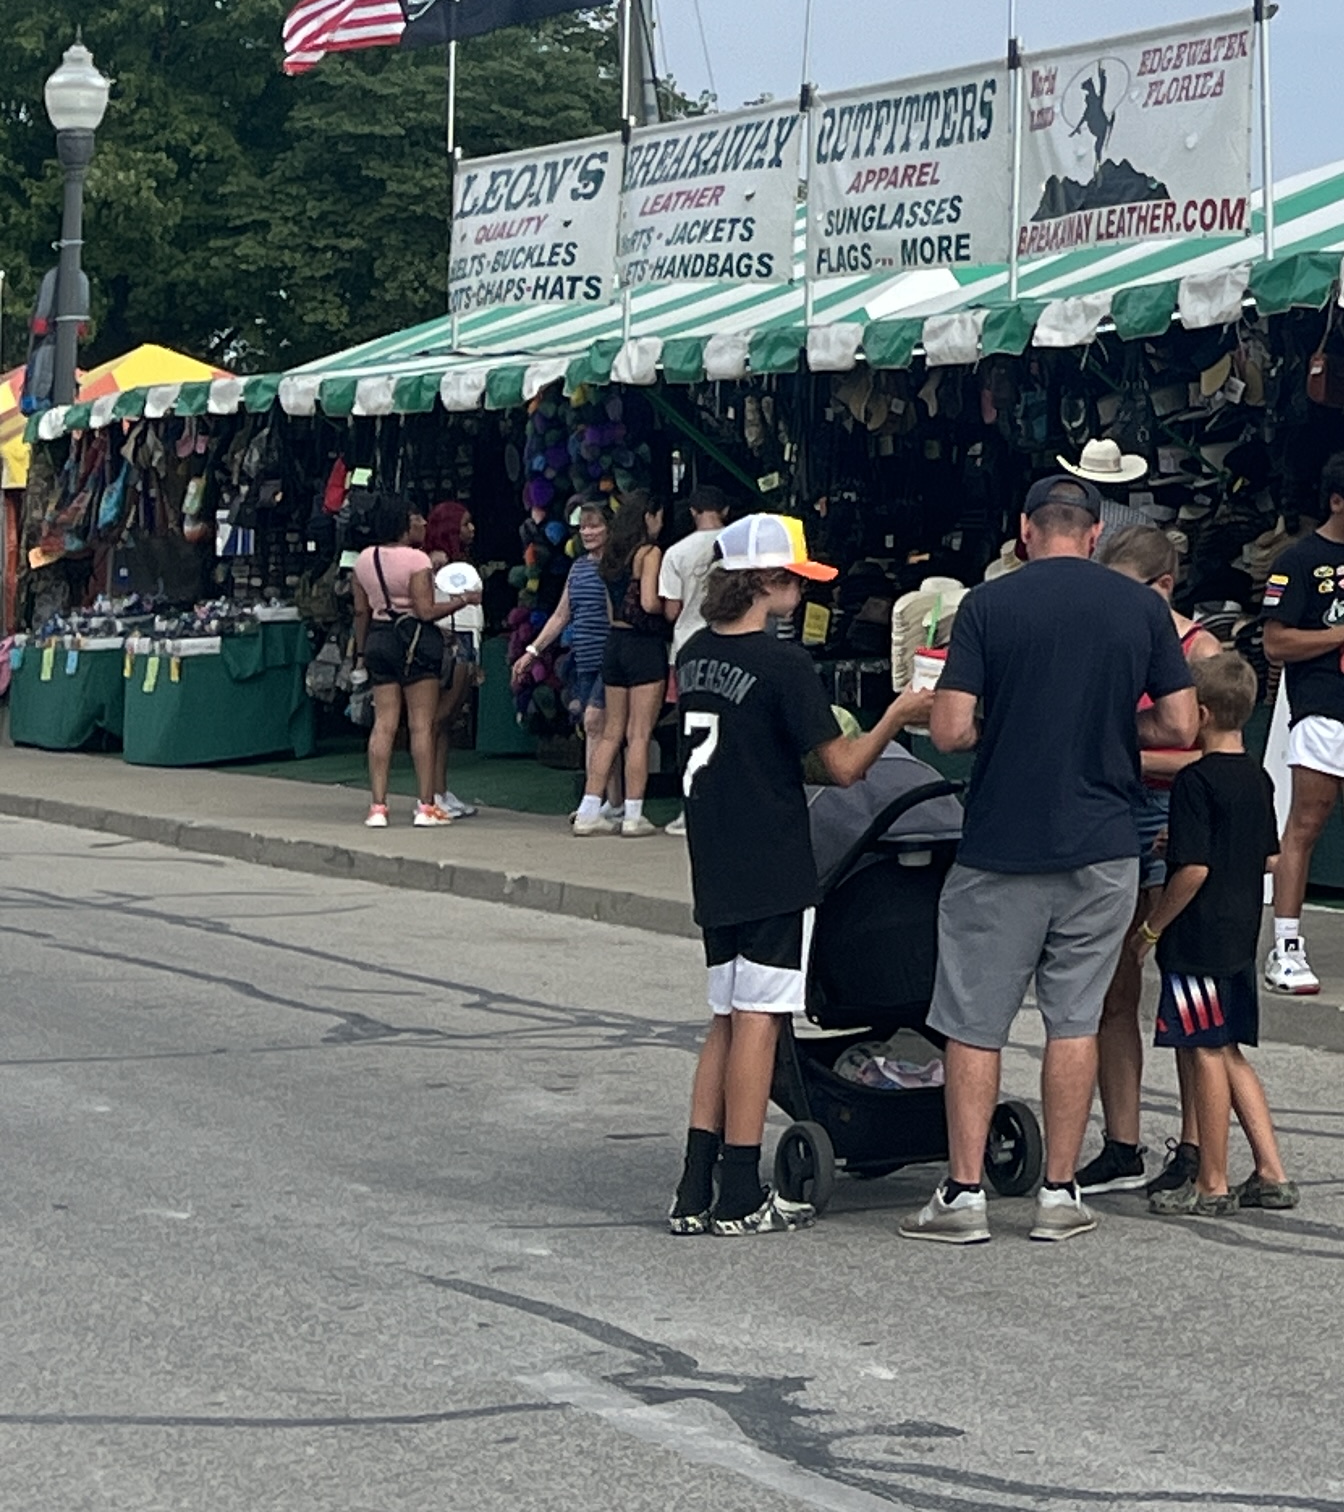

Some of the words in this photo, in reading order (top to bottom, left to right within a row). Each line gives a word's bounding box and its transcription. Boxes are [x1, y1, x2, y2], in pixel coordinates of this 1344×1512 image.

[1137, 30, 1249, 76] EDGEWATER
[1142, 70, 1226, 108] FLORIDA
[816, 78, 996, 164] OUTFITTERS
[624, 114, 799, 191] BREAKAWAY
[454, 152, 608, 220] LEON'S
[846, 162, 940, 195] APPAREL
[639, 185, 725, 217] LEATHER
[824, 195, 963, 237] SUNGLASSES
[1096, 197, 1247, 241] LEATHER.COM
[475, 214, 549, 245] QUALITY
[665, 216, 756, 247] JACKETS
[901, 233, 971, 266] MORE
[683, 711, 720, 798] 7
